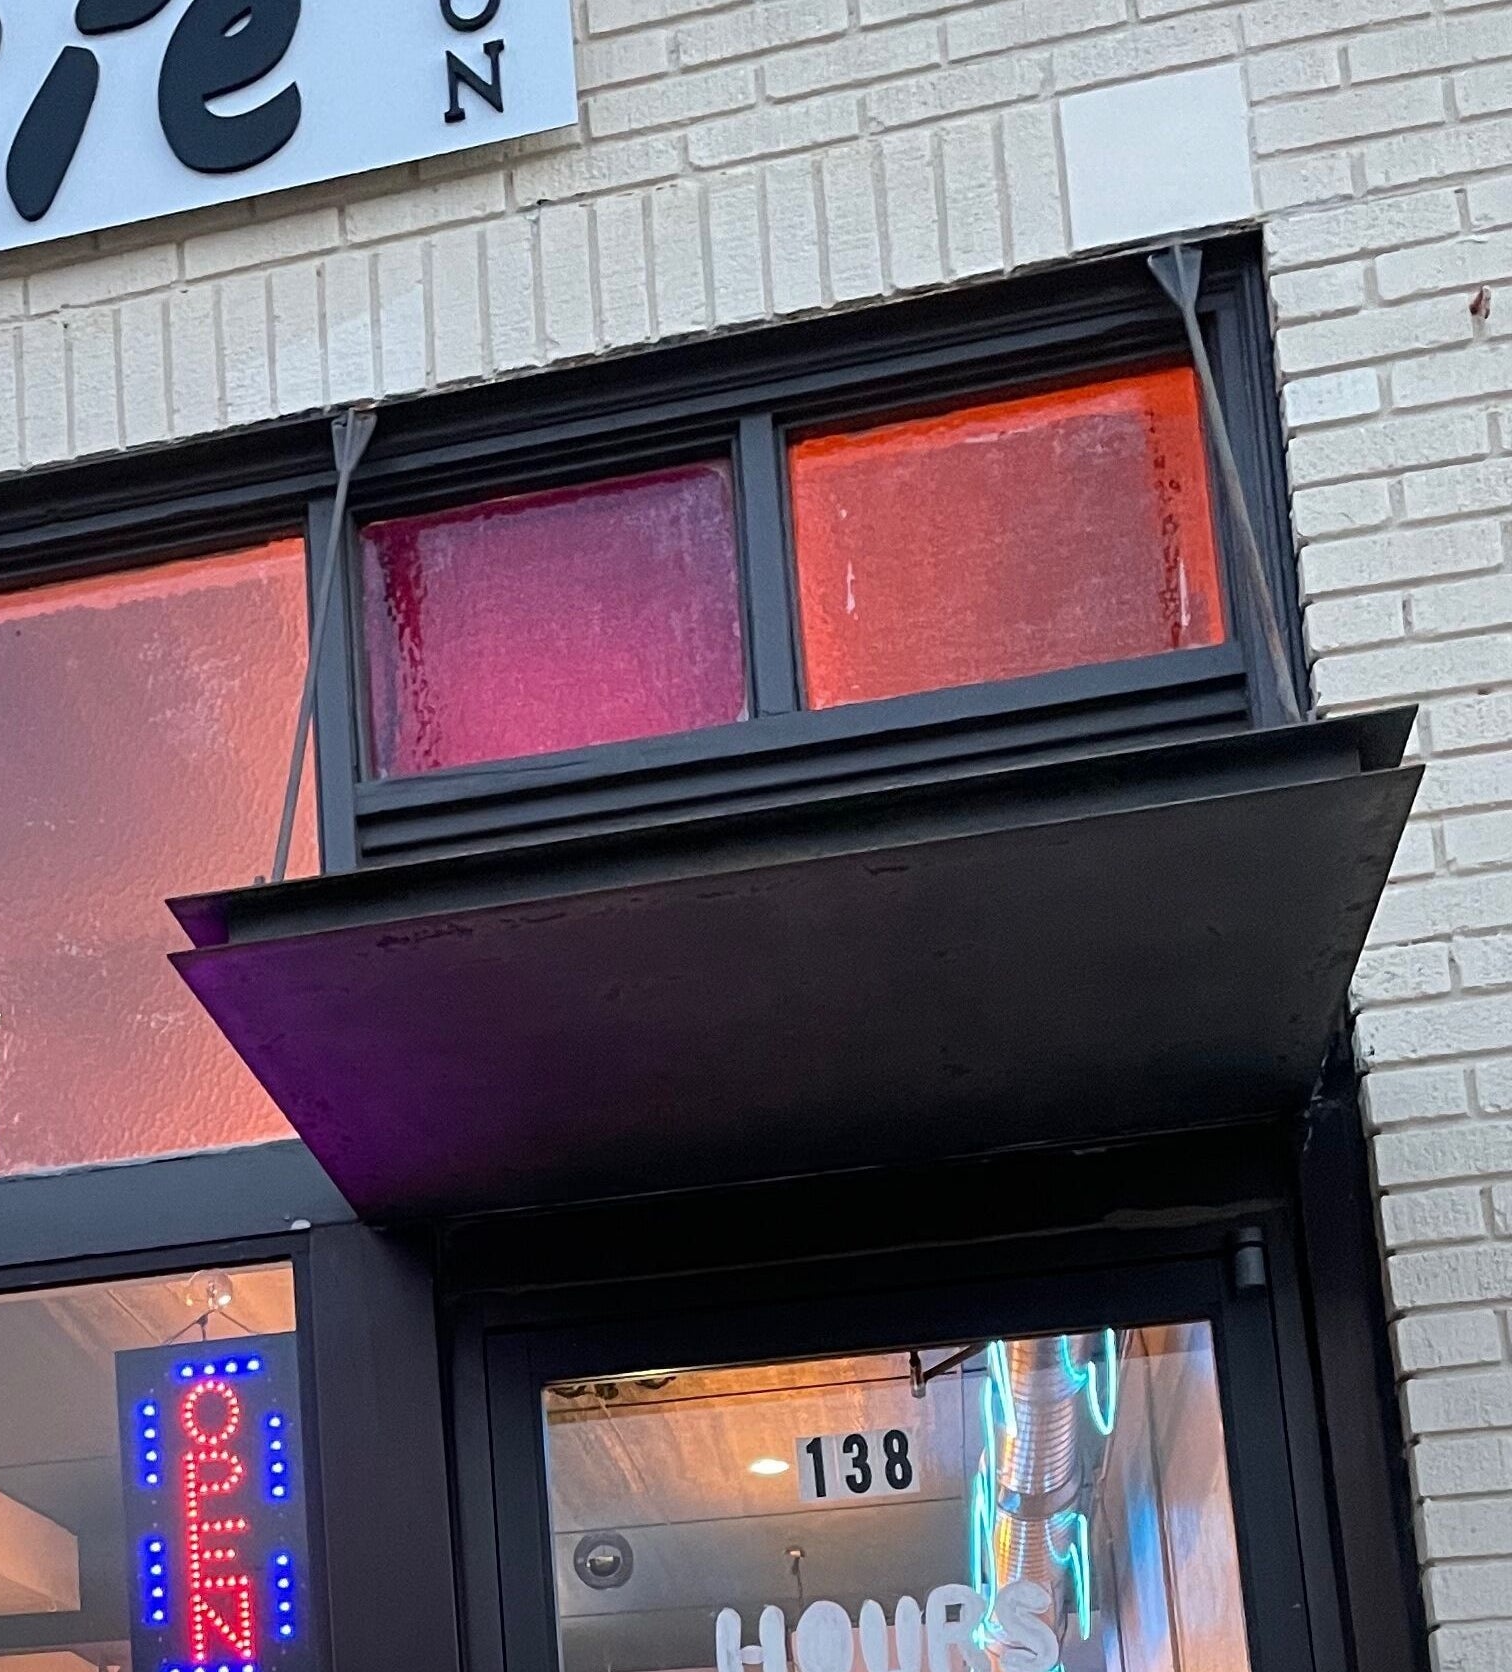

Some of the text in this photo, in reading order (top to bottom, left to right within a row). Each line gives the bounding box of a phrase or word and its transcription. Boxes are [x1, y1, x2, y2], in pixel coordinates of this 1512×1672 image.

[806, 1429, 913, 1498] 138
[181, 1377, 254, 1661] OPEN
[716, 1581, 1059, 1672] HOURS
